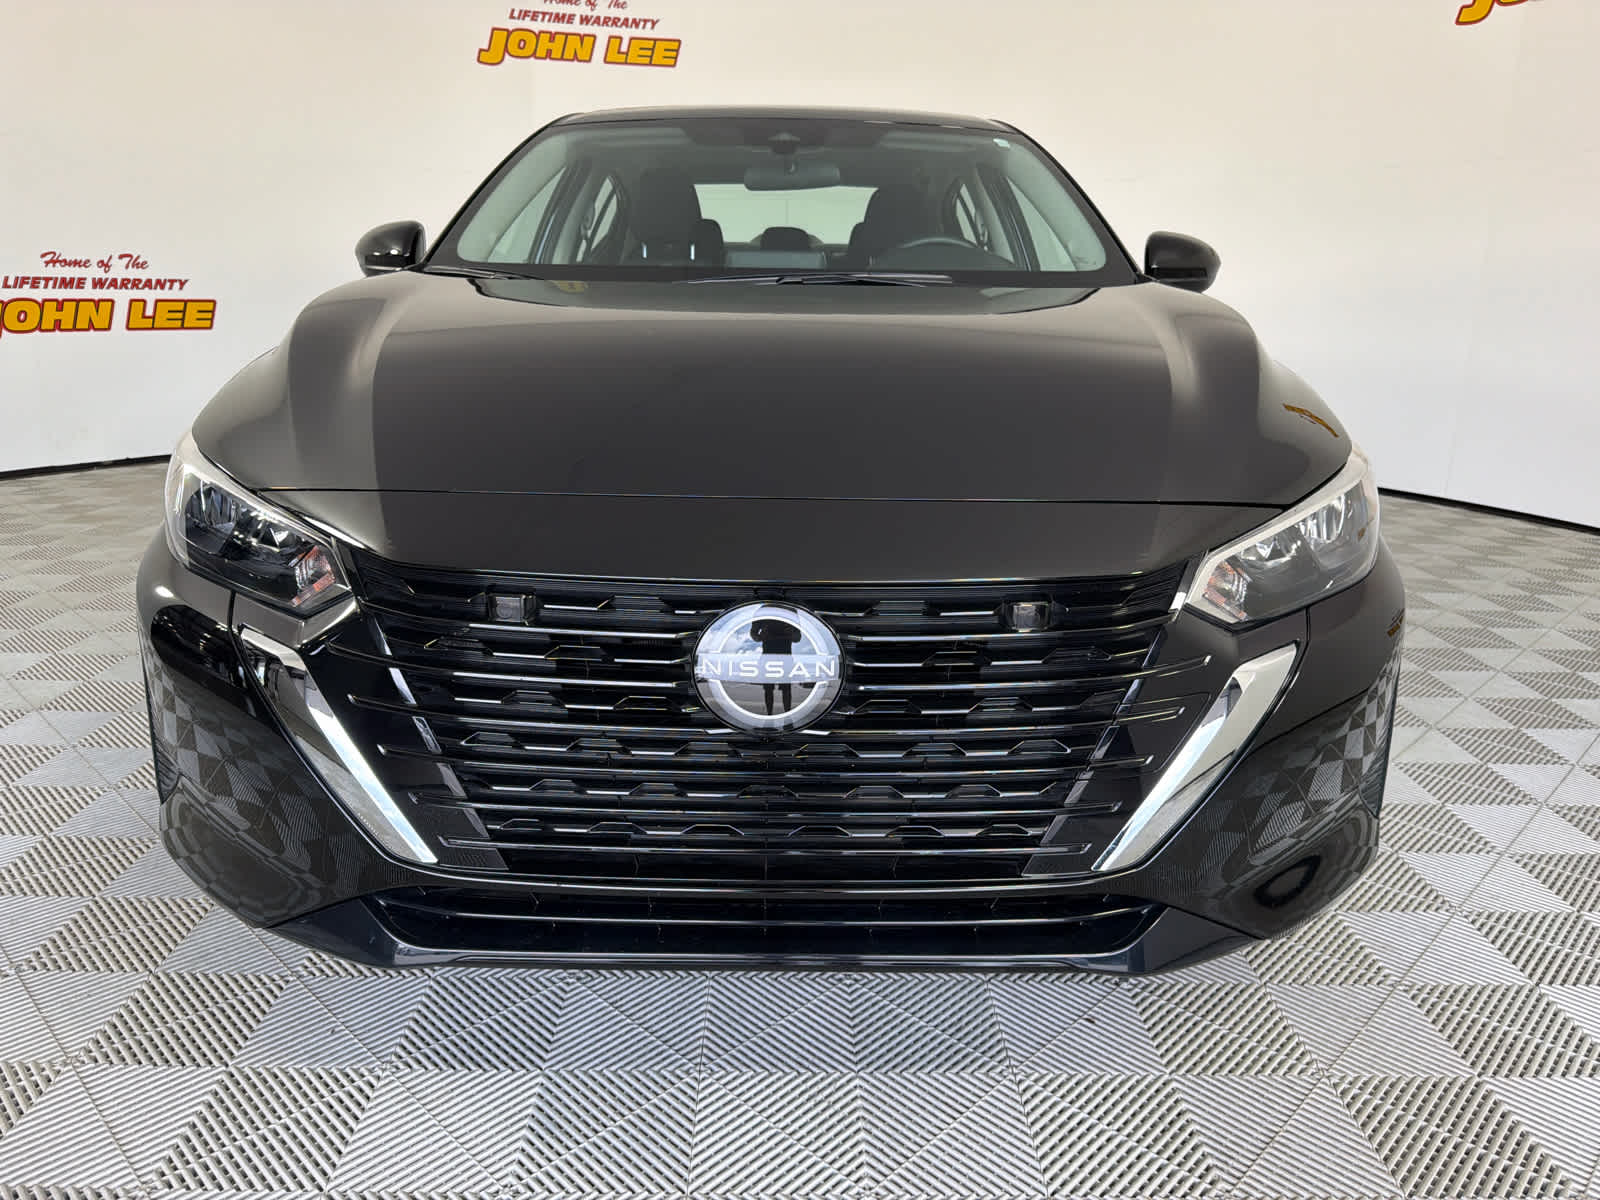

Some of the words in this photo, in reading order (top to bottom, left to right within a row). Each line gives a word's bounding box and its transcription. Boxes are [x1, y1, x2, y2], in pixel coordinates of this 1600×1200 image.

[508, 8, 576, 25] LIFETIME
[579, 14, 659, 30] WARRANTY
[477, 27, 596, 66] JOHN
[604, 35, 681, 67] LEE
[40, 251, 91, 268] Home
[97, 255, 113, 273] of
[118, 253, 149, 270] The
[2, 276, 86, 289] LIFETIME
[91, 277, 190, 291] WARRANTY
[0, 297, 115, 335] OHN
[126, 299, 216, 330] LEE
[700, 658, 836, 678] NISSAN
